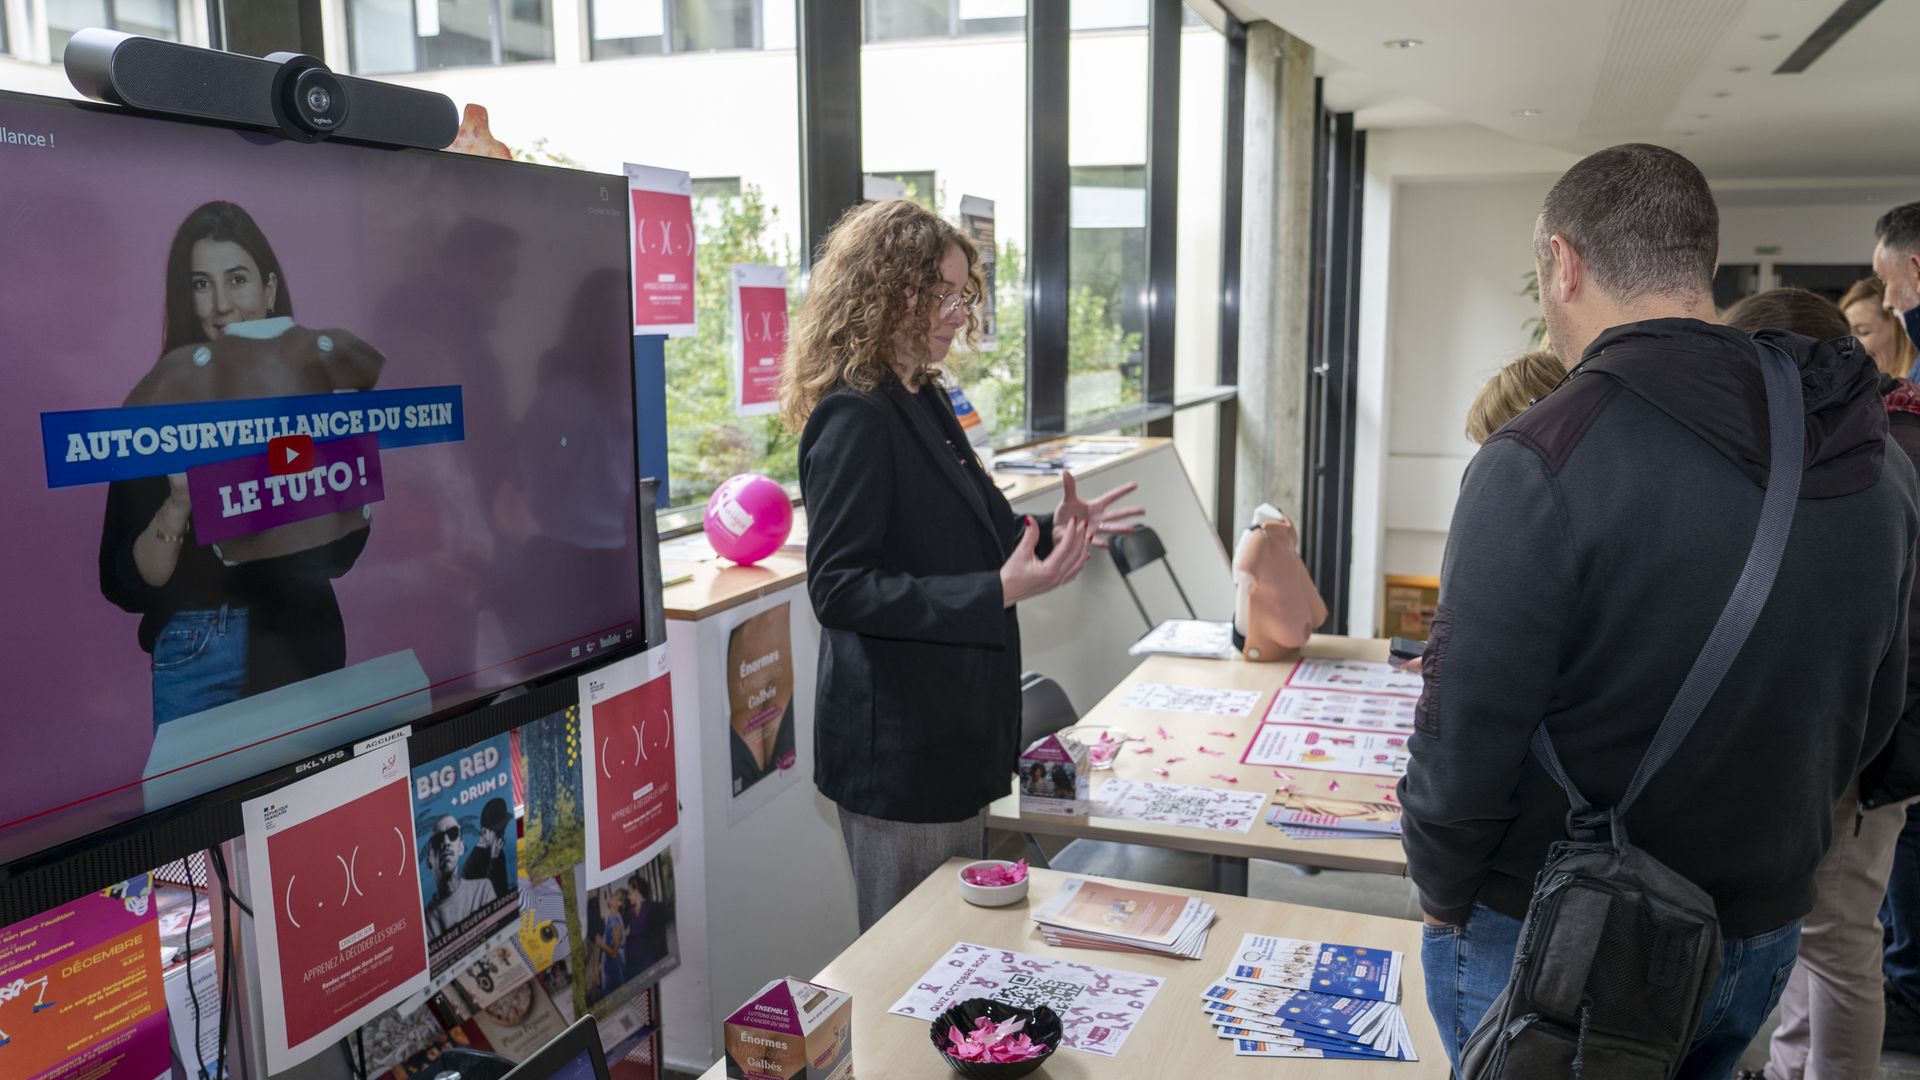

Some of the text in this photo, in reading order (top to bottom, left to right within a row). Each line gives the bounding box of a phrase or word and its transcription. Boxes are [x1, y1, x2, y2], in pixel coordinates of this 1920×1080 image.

[0, 127, 46, 148] llance
[65, 401, 454, 463] AUTOSURVEILLANCE DU SEIN
[218, 456, 368, 518] LE TUTO !
[740, 649, 780, 679] Énormes
[365, 732, 406, 749] ACCUEIL
[295, 750, 345, 774] EKLYPS
[416, 764, 456, 800] BIG
[460, 746, 500, 781] RED
[460, 777, 497, 805] DRUM
[498, 772, 508, 787] D
[61, 934, 144, 979] DÉCEMBRE
[303, 918, 407, 984] APPRENEZ À DÉCODER LES SIGNES
[0, 958, 33, 976] armonie
[930, 952, 992, 1012] QUIZ OCTOBRE ROSE
[747, 1009, 770, 1019] LUTTONS
[740, 1031, 789, 1051] Énormes
[747, 1056, 783, 1073] Galbés
